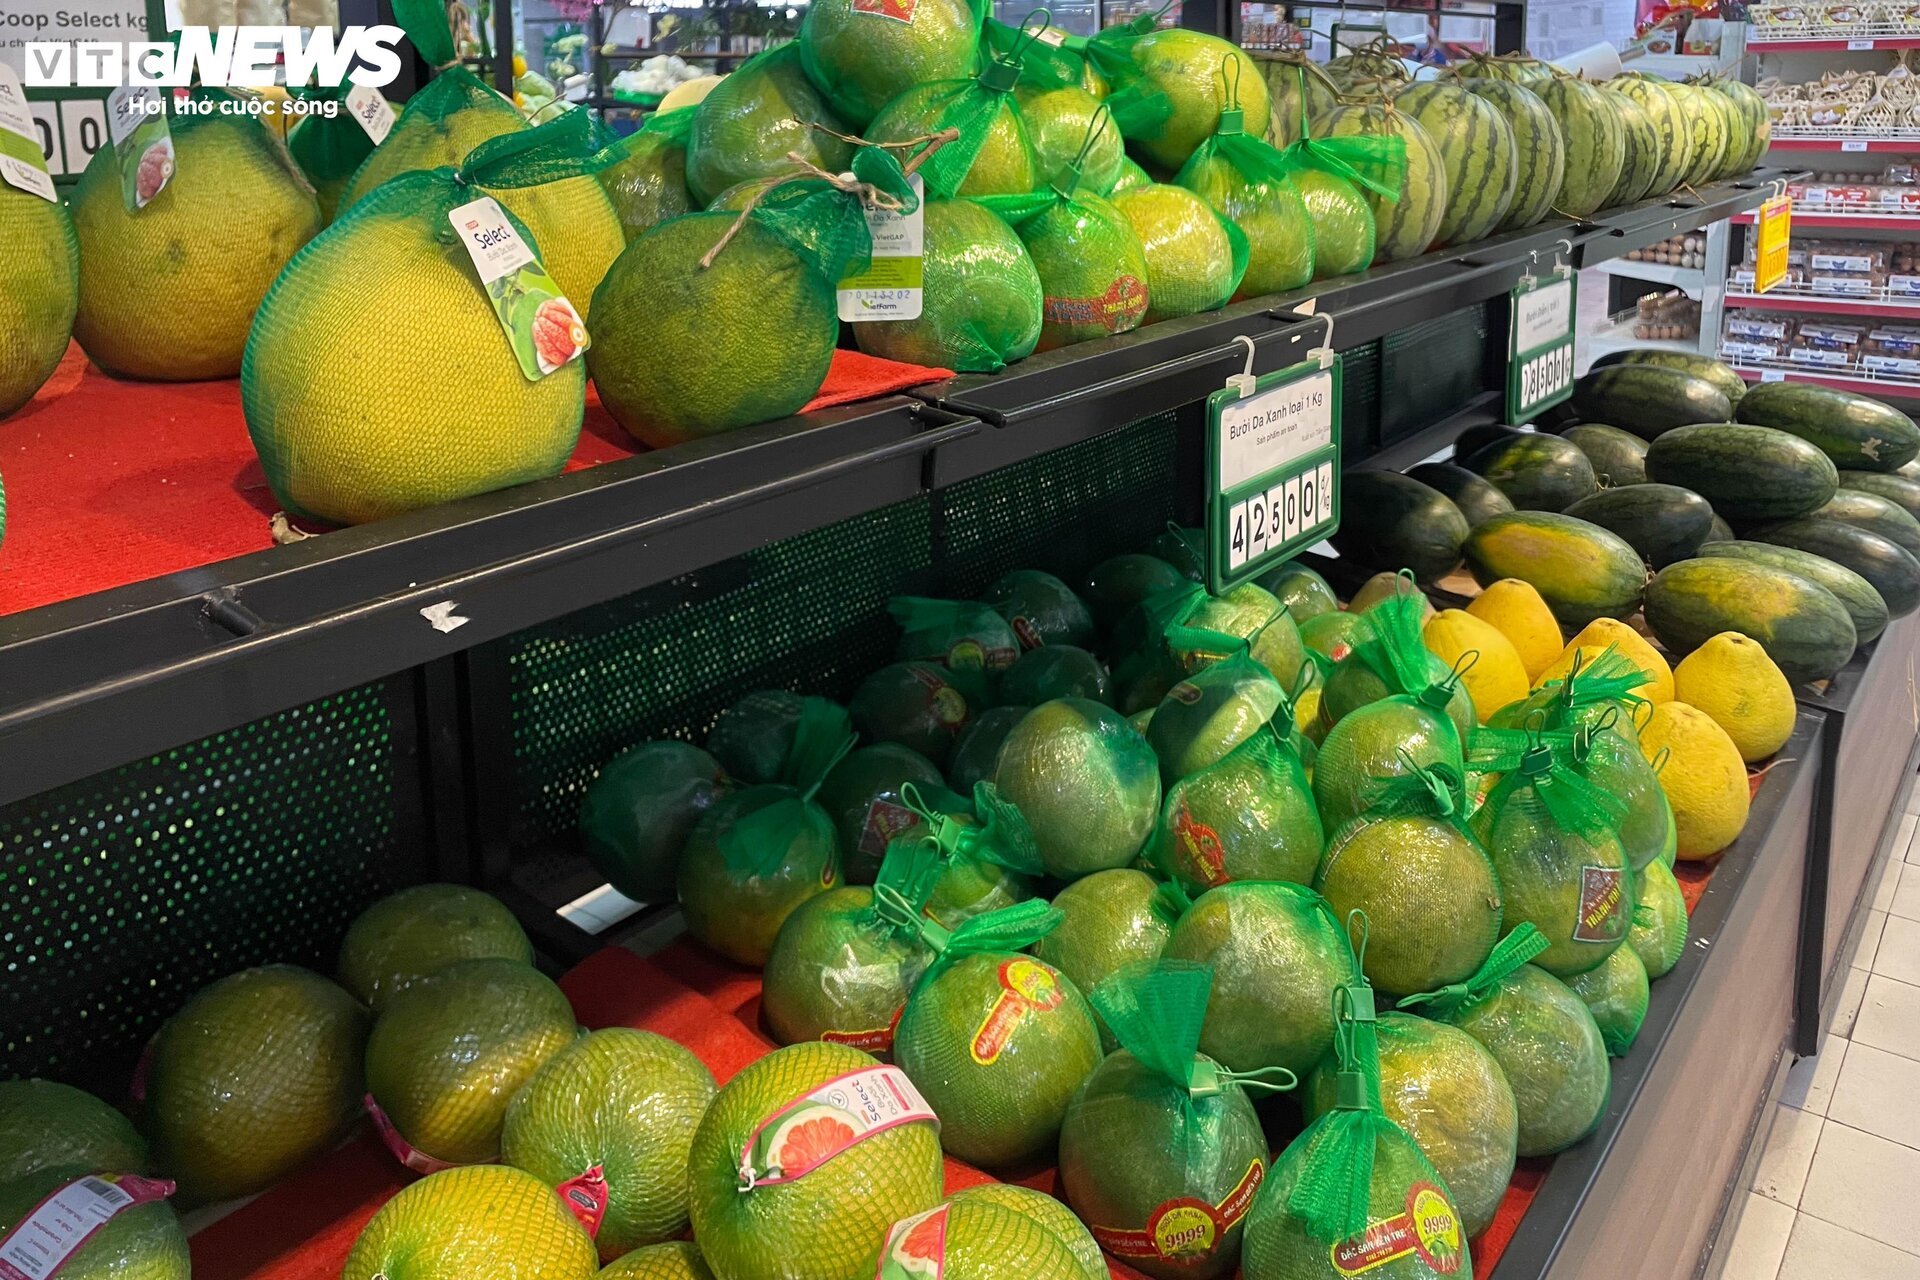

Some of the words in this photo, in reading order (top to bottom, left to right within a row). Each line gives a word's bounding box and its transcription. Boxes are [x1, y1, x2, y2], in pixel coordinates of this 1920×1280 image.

[56, 11, 121, 28] Select
[126, 12, 149, 33] kg
[360, 96, 383, 124] Select
[474, 224, 511, 249] Select
[1252, 415, 1264, 430] Da
[1266, 405, 1287, 424] Xanh
[1289, 398, 1304, 415] loại
[1306, 396, 1310, 408] 1
[1312, 392, 1323, 407] Kg
[852, 1079, 882, 1123] Select
[1164, 1224, 1207, 1248] 9999
[1423, 1215, 1452, 1234] 9999
